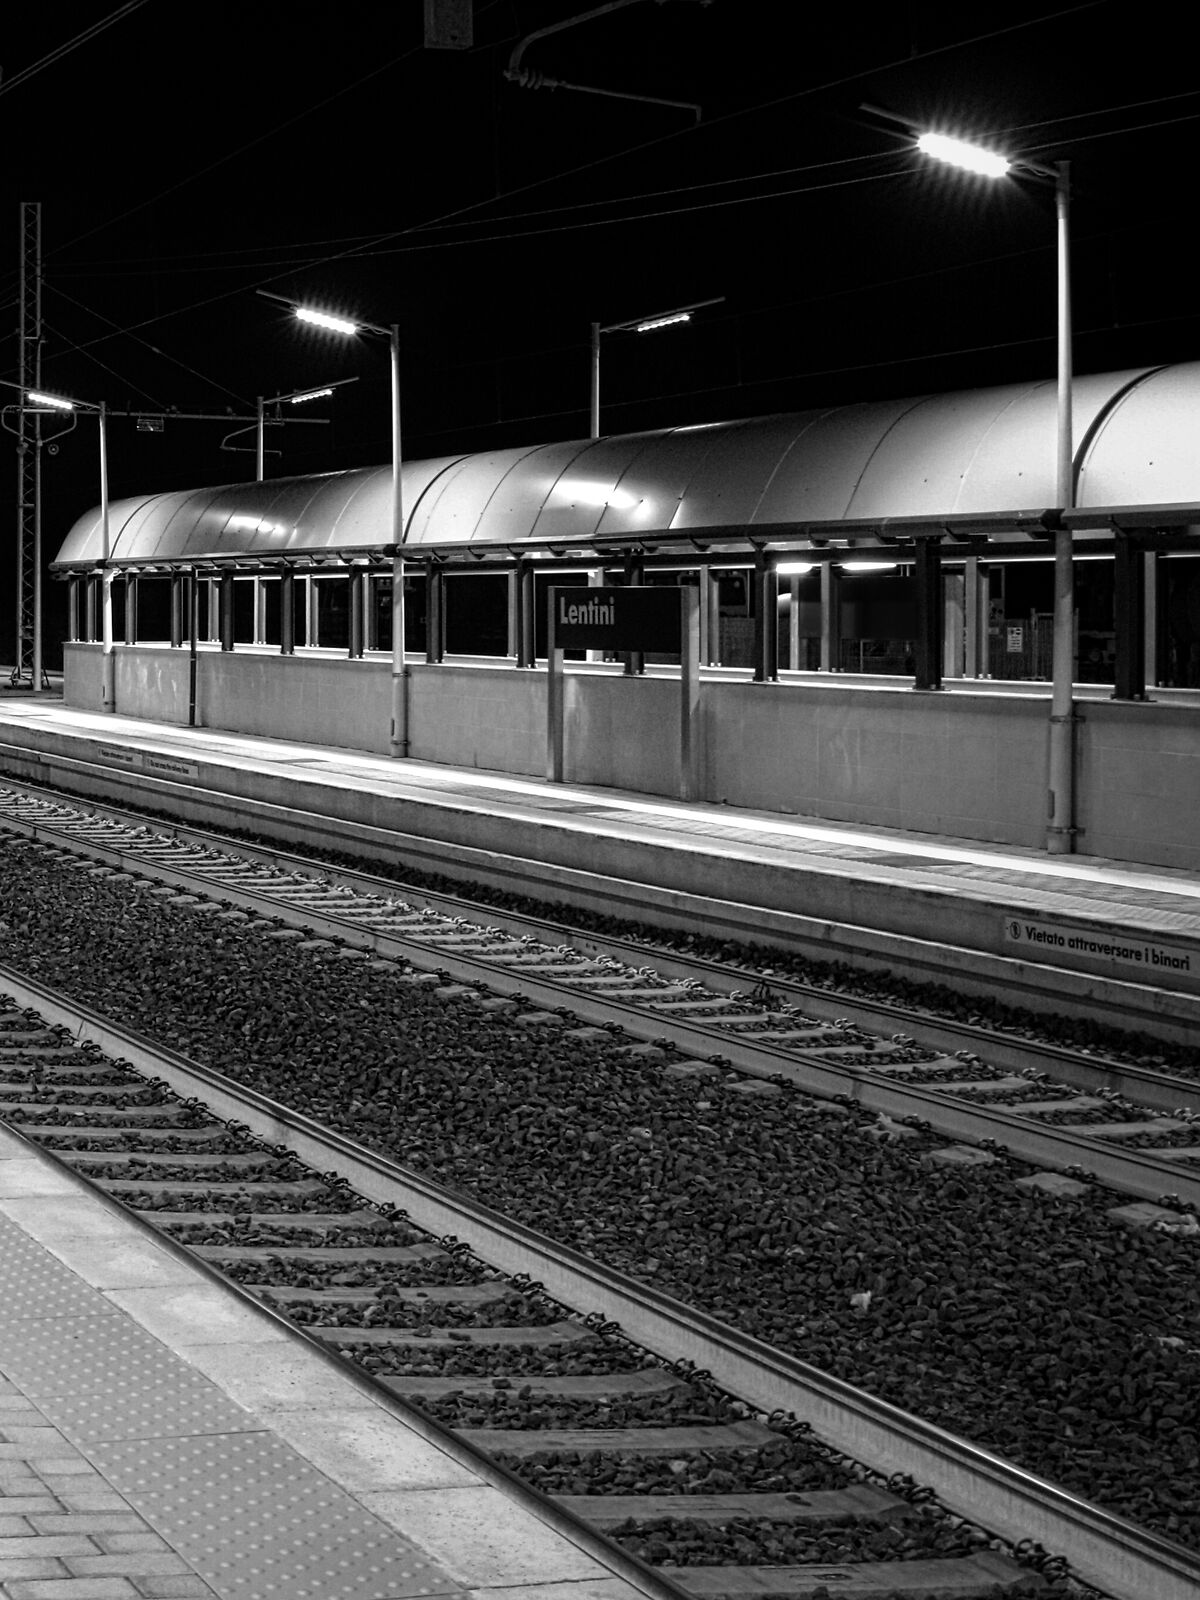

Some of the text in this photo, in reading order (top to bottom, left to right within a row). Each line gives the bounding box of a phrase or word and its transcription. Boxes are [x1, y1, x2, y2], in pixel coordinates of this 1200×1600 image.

[560, 596, 615, 624] Lentini
[1025, 926, 1190, 971] Vietato attraversare i binari
